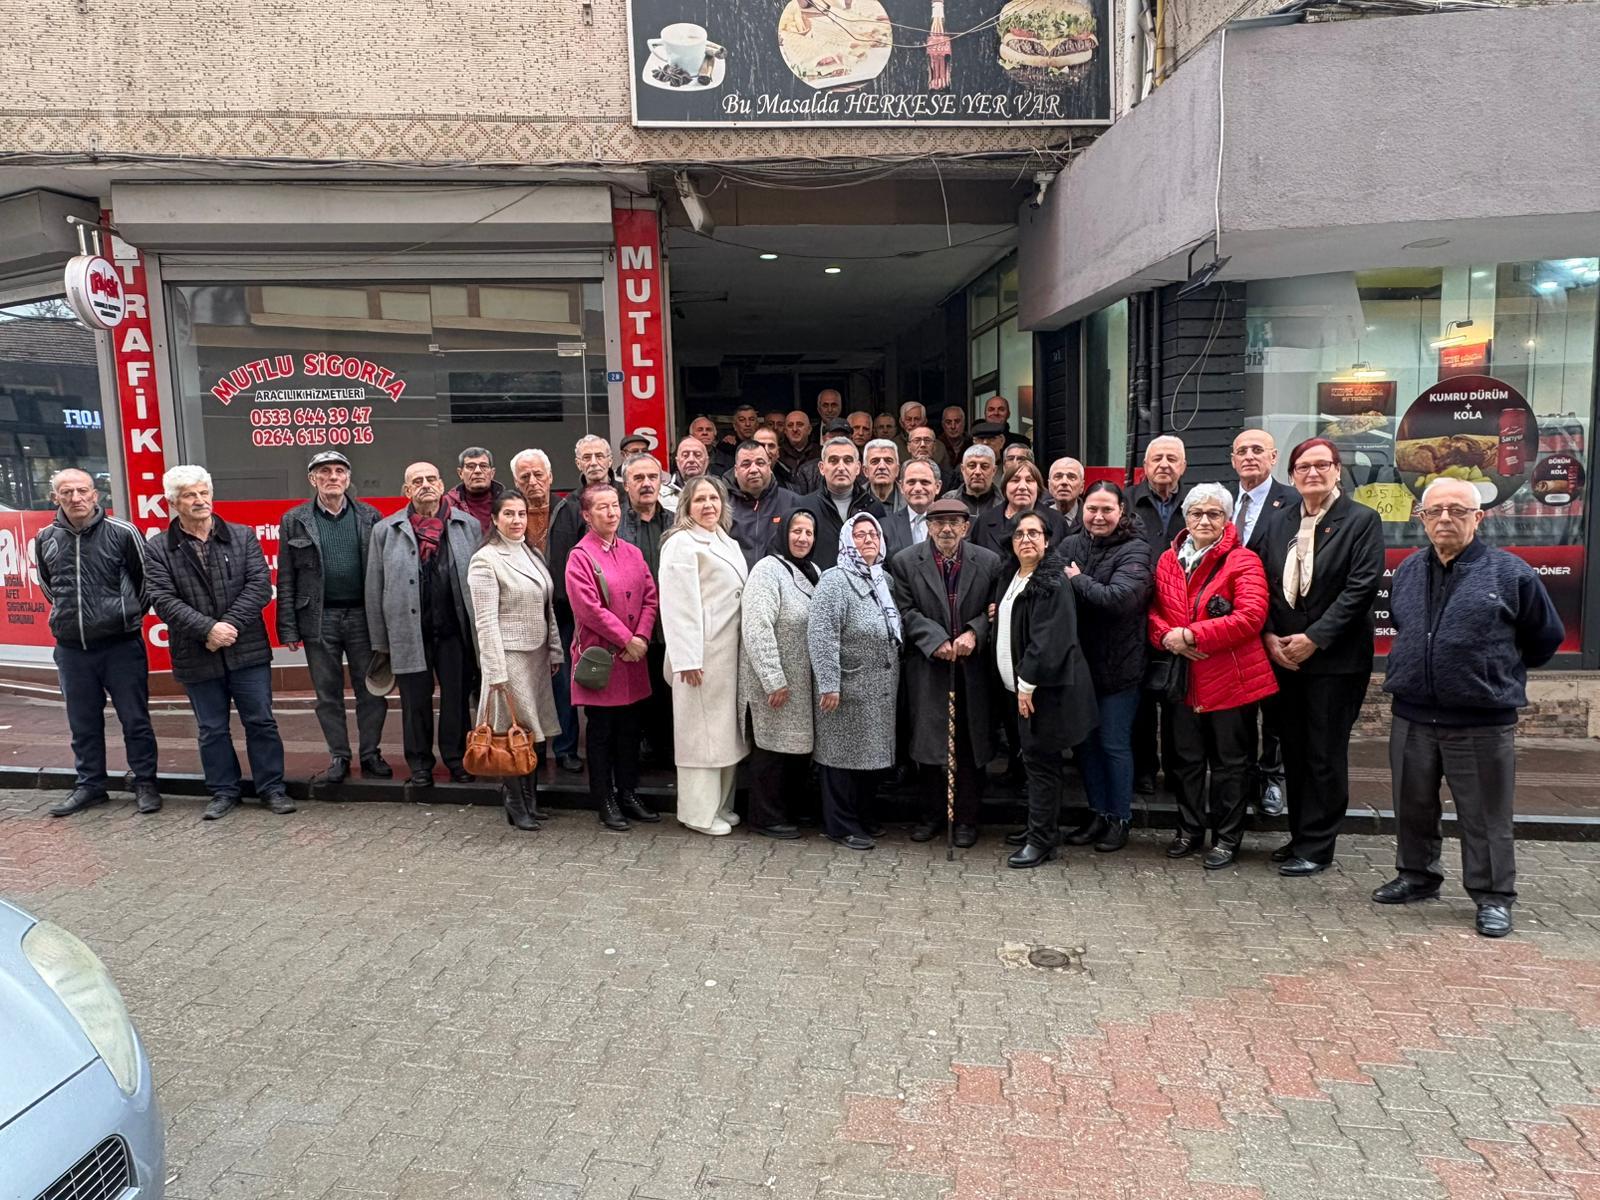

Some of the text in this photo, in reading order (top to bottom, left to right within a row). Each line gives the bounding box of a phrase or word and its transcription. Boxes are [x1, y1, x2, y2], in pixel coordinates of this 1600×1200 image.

[722, 92, 1064, 117] Bu Masalda HERKESE YER VAR
[621, 246, 656, 399] MUTLU
[211, 354, 294, 406] MUTLU
[255, 390, 303, 401] ARACILIK
[1429, 389, 1508, 402] KUMRU DÜRÜM
[250, 406, 372, 427] 0533 644 39 47
[1454, 411, 1482, 420] KOLA
[252, 426, 374, 446] 0264 615 00 16
